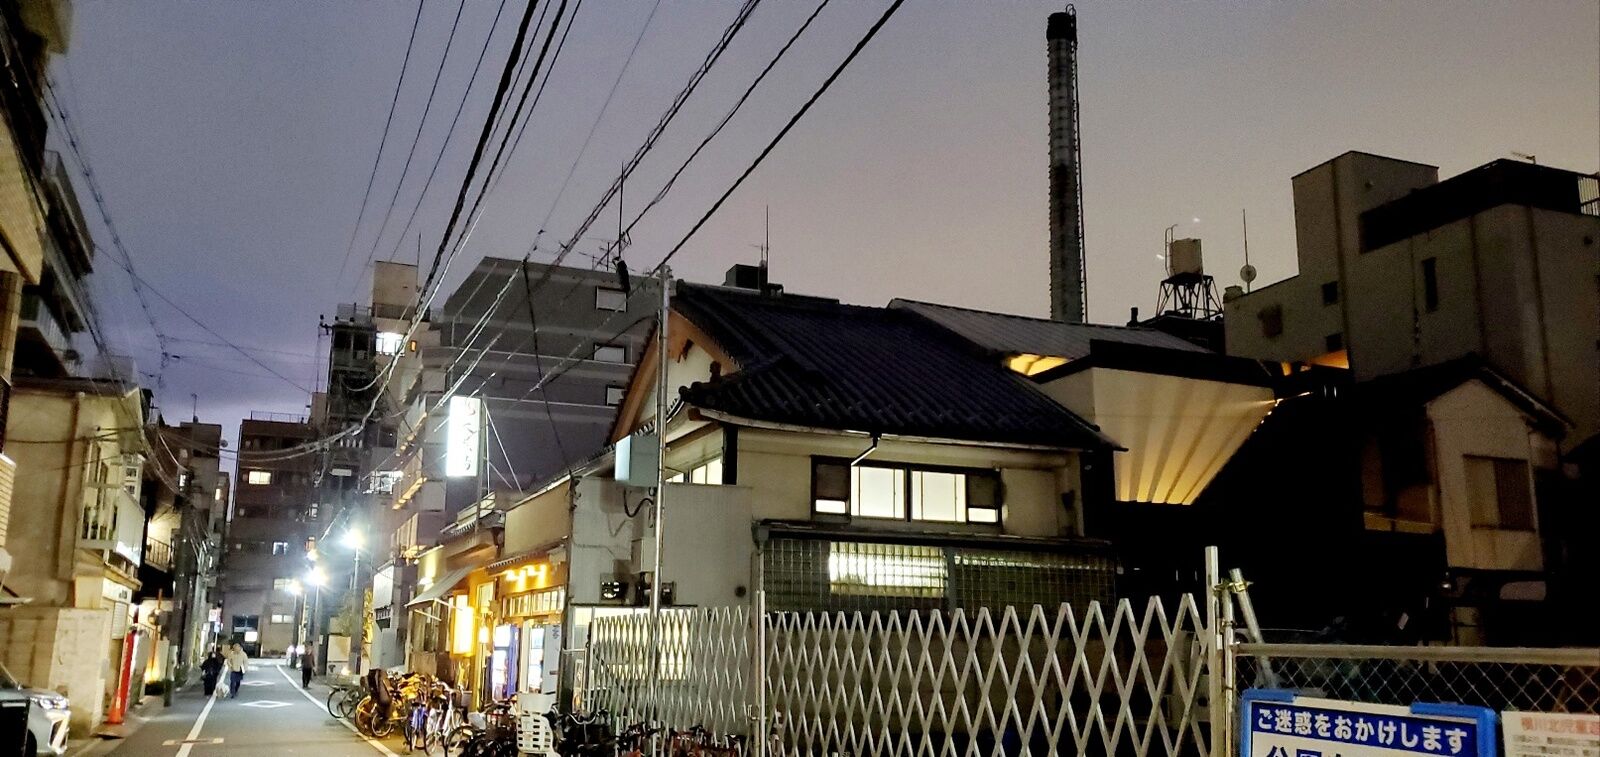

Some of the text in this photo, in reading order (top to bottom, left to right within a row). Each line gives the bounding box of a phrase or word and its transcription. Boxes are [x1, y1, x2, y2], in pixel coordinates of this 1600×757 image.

[1258, 708, 1468, 754] ご迷惑をおかけします
